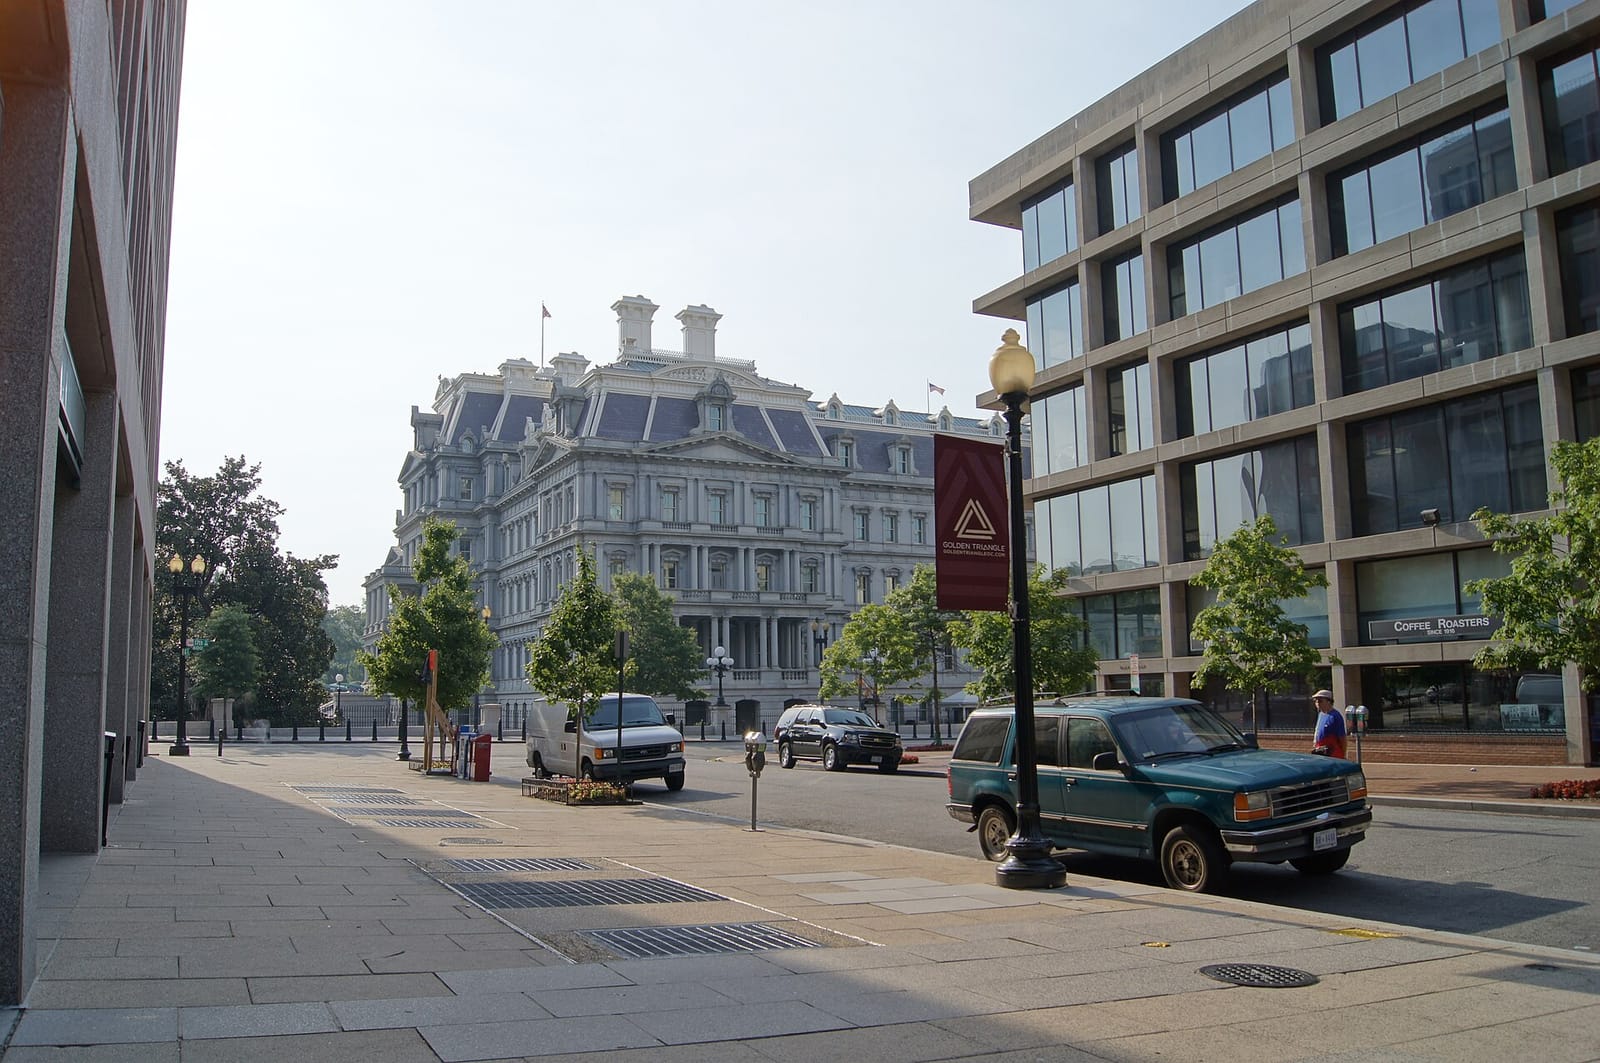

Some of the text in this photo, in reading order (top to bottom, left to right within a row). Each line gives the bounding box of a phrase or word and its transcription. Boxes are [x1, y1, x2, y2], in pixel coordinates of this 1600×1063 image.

[943, 541, 1006, 552] GOLDEN TRIANGLE
[1394, 617, 1490, 632] COFFEE ROASTERS
